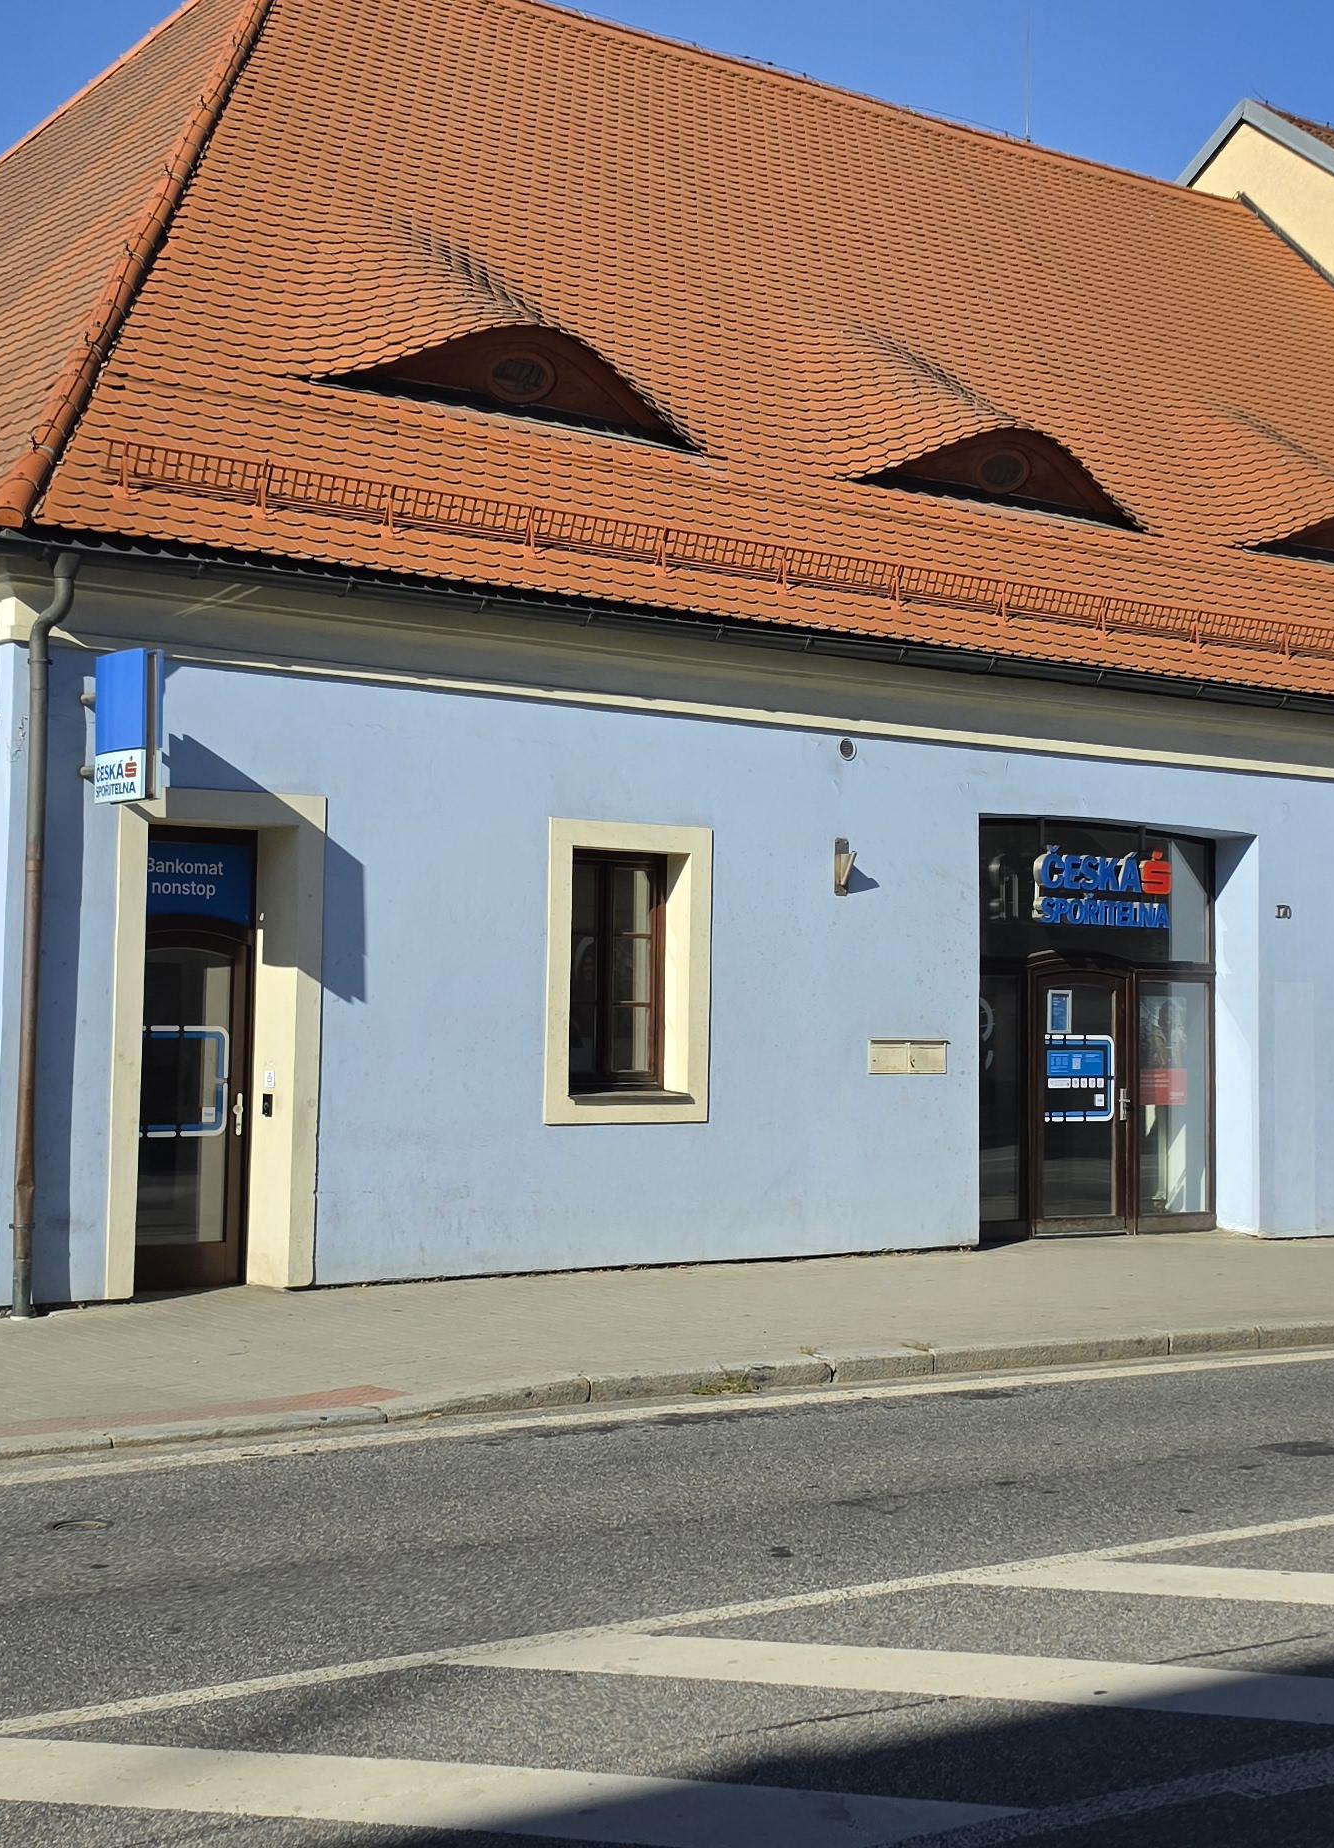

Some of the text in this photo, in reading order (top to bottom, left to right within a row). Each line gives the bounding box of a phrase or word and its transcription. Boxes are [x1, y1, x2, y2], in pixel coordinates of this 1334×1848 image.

[95, 760, 124, 783] ČESKÁ
[95, 781, 136, 798] SPOŘITELNA
[147, 857, 224, 876] Bankomat
[1036, 844, 1142, 893] ČESKÁ
[152, 881, 216, 899] nonstop
[1035, 893, 1171, 929] SPOŘITELNA
